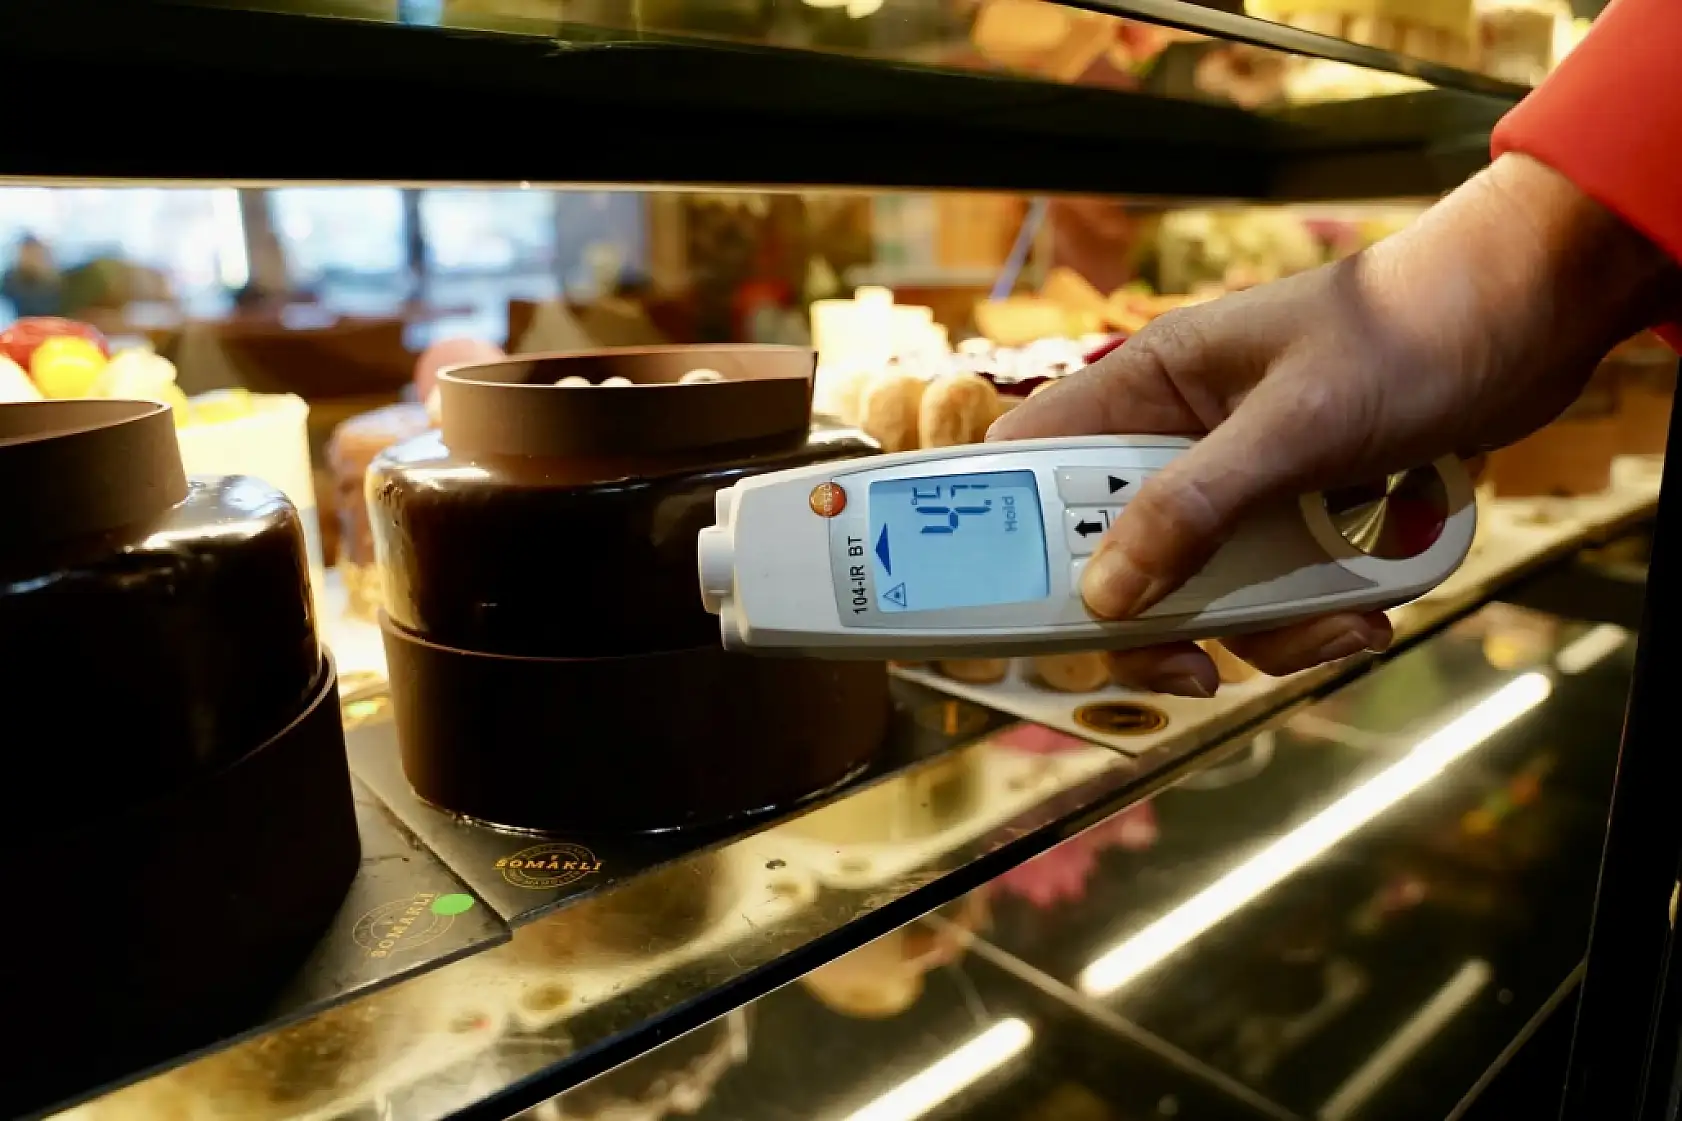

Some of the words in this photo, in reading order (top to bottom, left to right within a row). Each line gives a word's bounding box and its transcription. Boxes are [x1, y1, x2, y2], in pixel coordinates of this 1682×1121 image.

[915, 484, 993, 534] 4.7
[1001, 496, 1019, 532] Hold
[848, 535, 864, 557] BT
[849, 565, 867, 615] 104-IR
